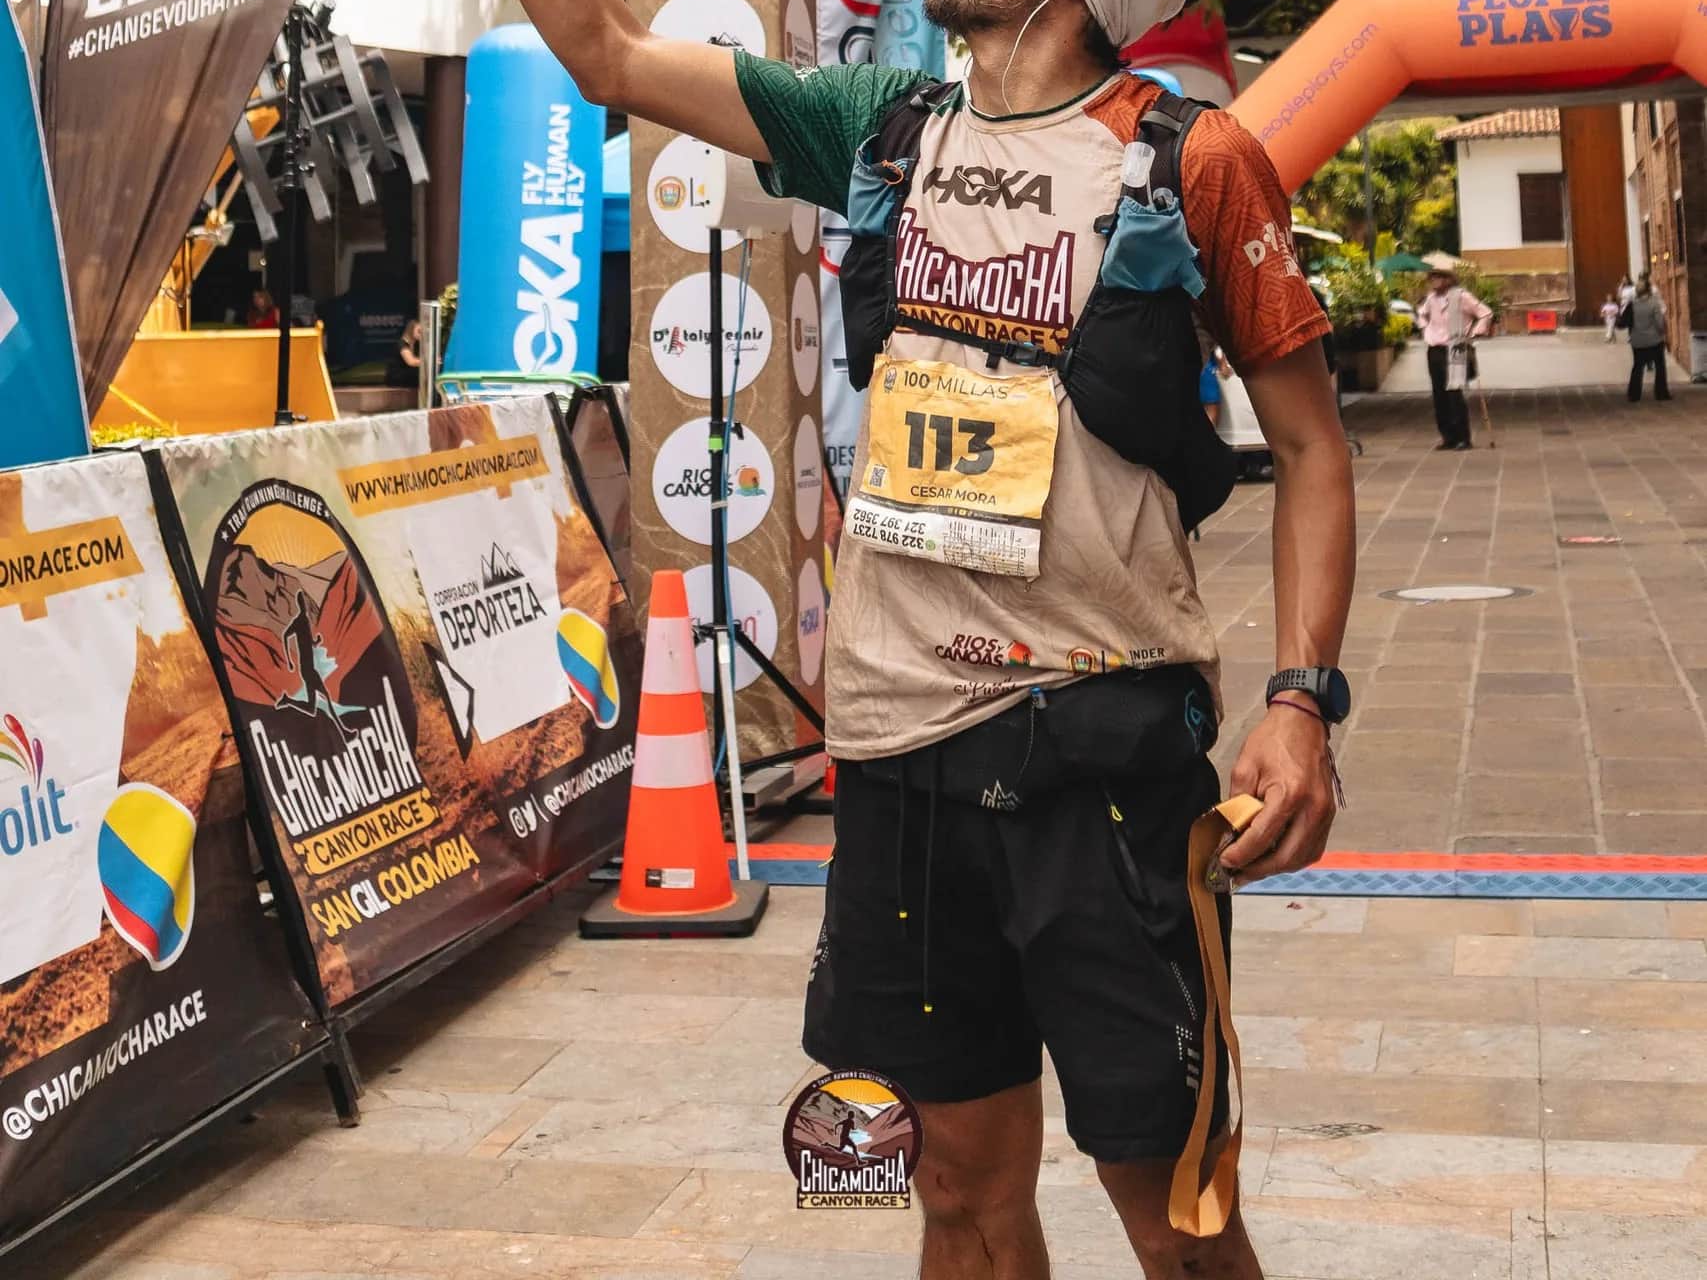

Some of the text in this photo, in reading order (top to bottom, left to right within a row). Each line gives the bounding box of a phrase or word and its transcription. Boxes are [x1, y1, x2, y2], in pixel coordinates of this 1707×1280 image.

[1457, 4, 1614, 48] PLAYS
[1260, 23, 1378, 145] eopleplays.com
[544, 104, 572, 206] HUMAN
[522, 161, 546, 206] FLY
[566, 162, 586, 206] FLY
[922, 165, 1054, 216] HOKA
[513, 210, 584, 382] OKA
[721, 328, 763, 341] ennis
[904, 370, 1010, 401] 100 MILLAS
[905, 410, 996, 476] 113
[279, 487, 323, 516] HALLENGE
[910, 485, 953, 500] CESAR
[954, 491, 997, 506] MORA
[853, 523, 924, 550] 322 978 7237
[440, 582, 548, 651] DEPORTEZA
[935, 645, 1004, 667] CANOAS
[952, 634, 999, 651] RIOS
[1129, 647, 1165, 661] INDER
[250, 675, 422, 837] CHICAMOCHA
[313, 798, 424, 866] CANYON RACE
[2, 989, 207, 1141] @CHICAMOCHARACE
